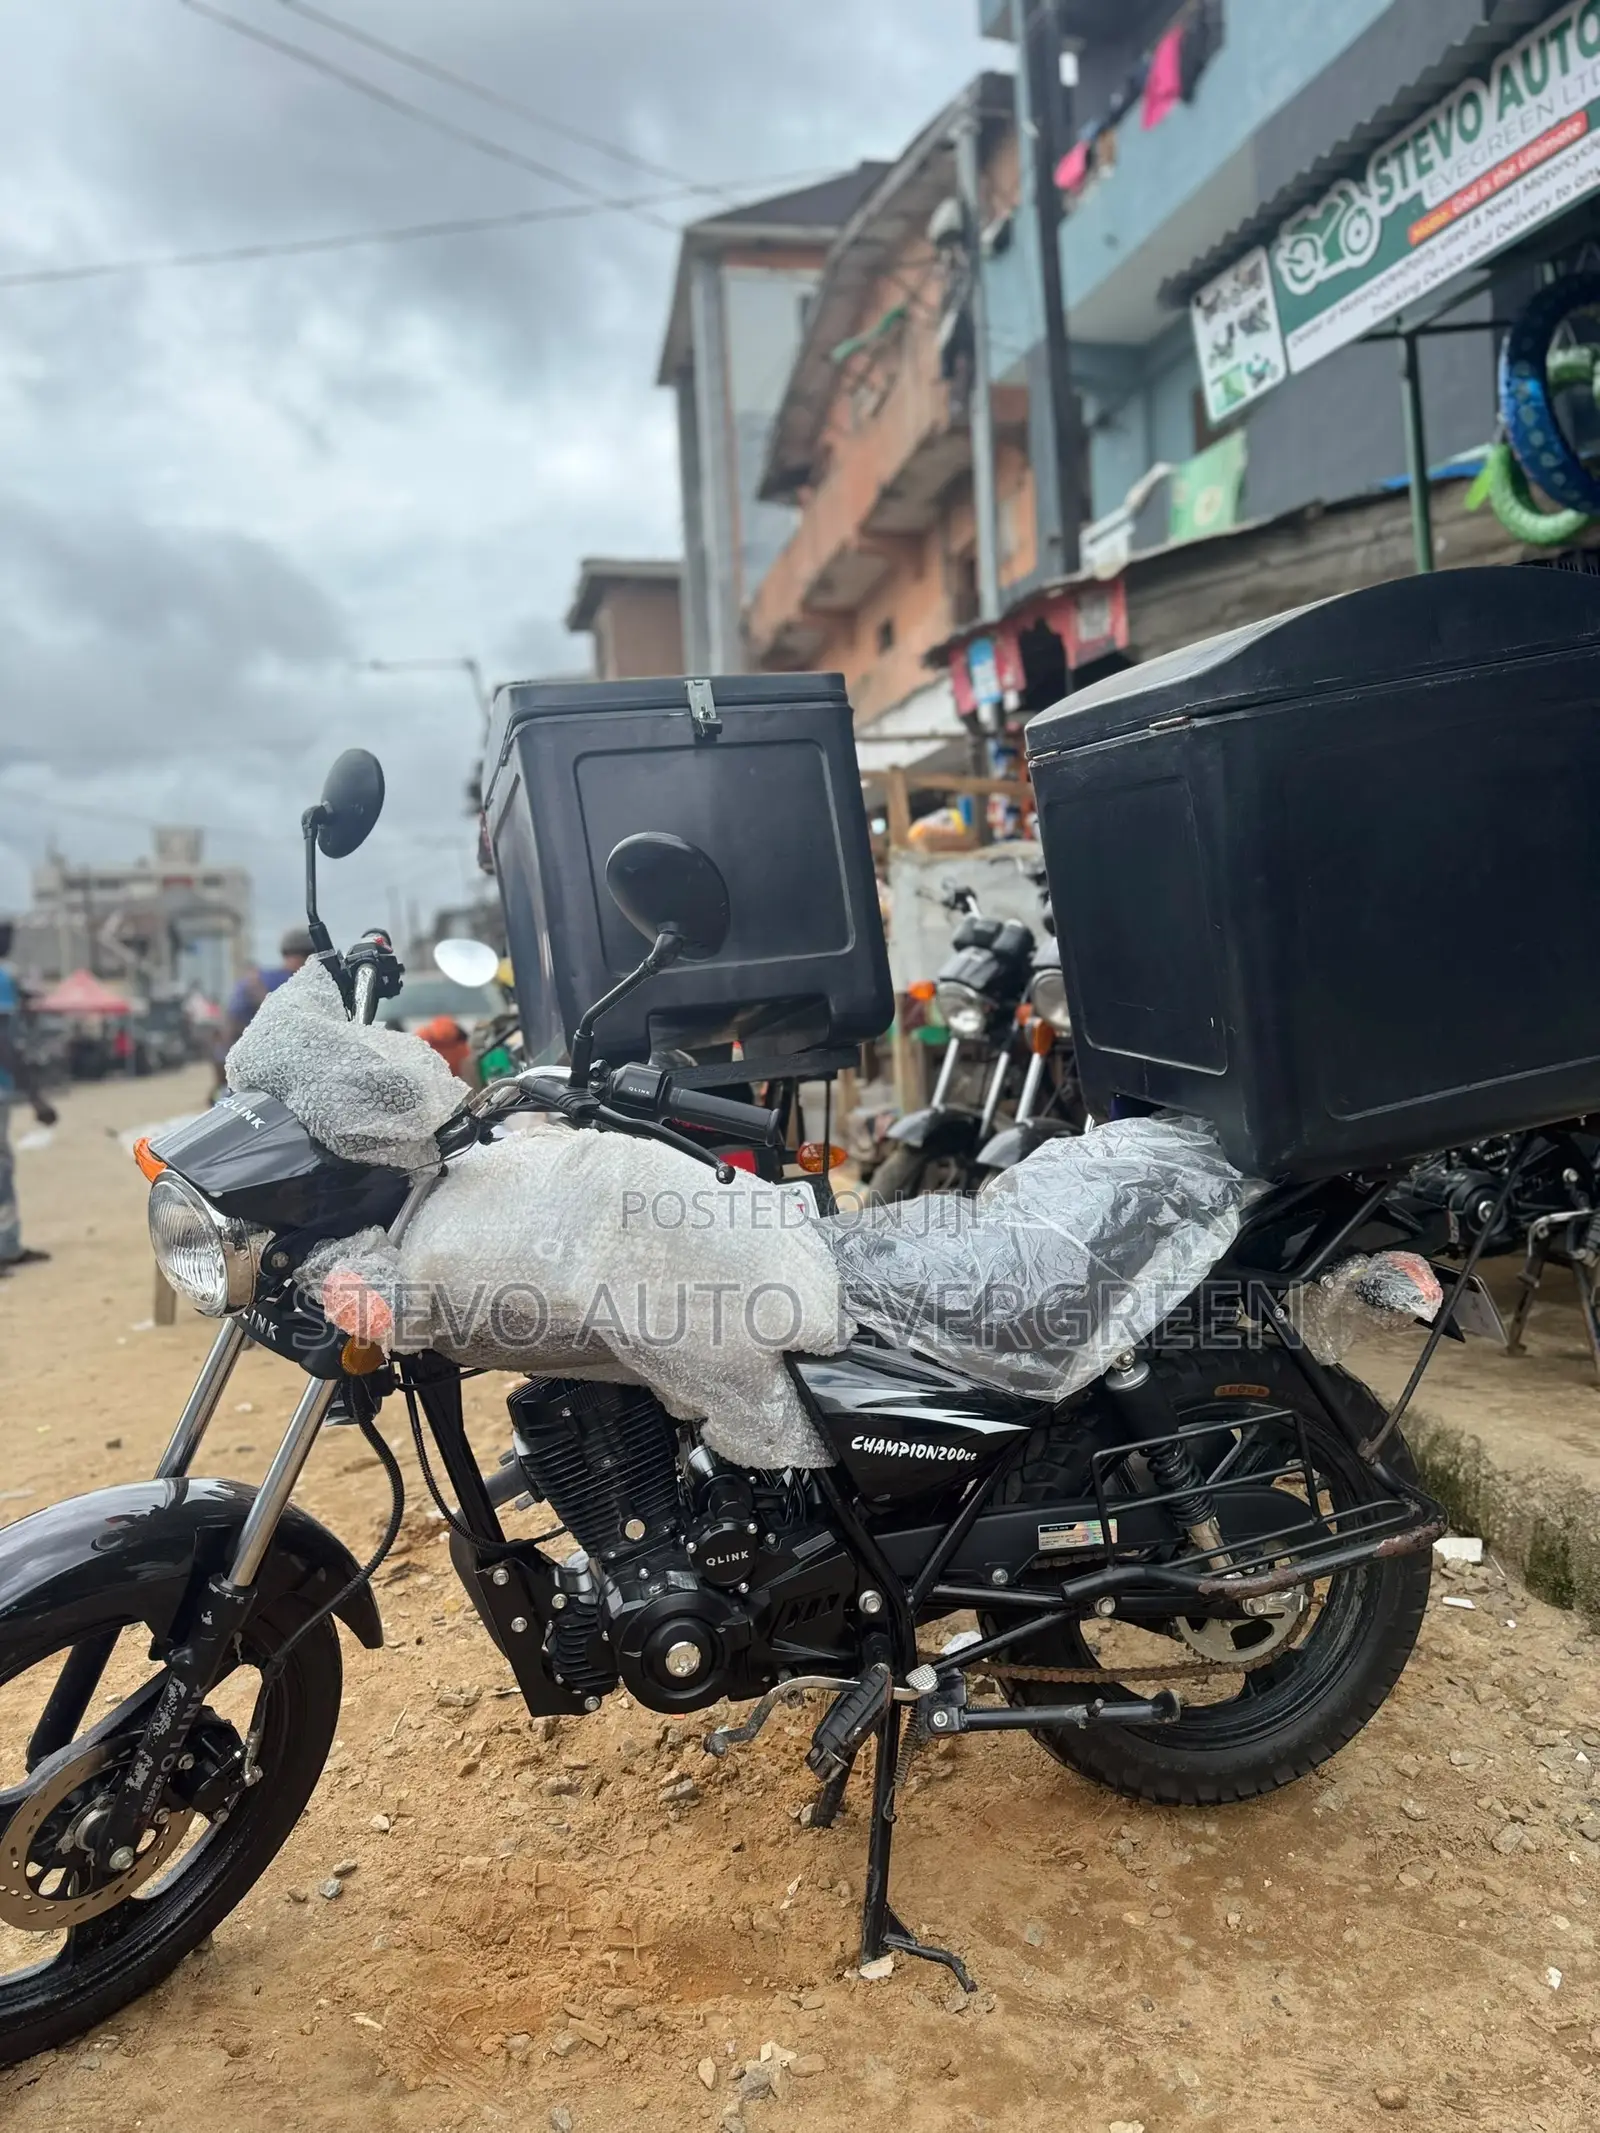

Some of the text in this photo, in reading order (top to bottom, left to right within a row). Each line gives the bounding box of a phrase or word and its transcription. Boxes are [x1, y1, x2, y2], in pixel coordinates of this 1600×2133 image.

[1374, 0, 1600, 206] STEVO AUTO
[1426, 99, 1555, 199] EVEGREEN
[629, 1086, 651, 1096] QLINK
[705, 1550, 750, 1567] QLINK
[142, 1773, 166, 1814] SUPER
